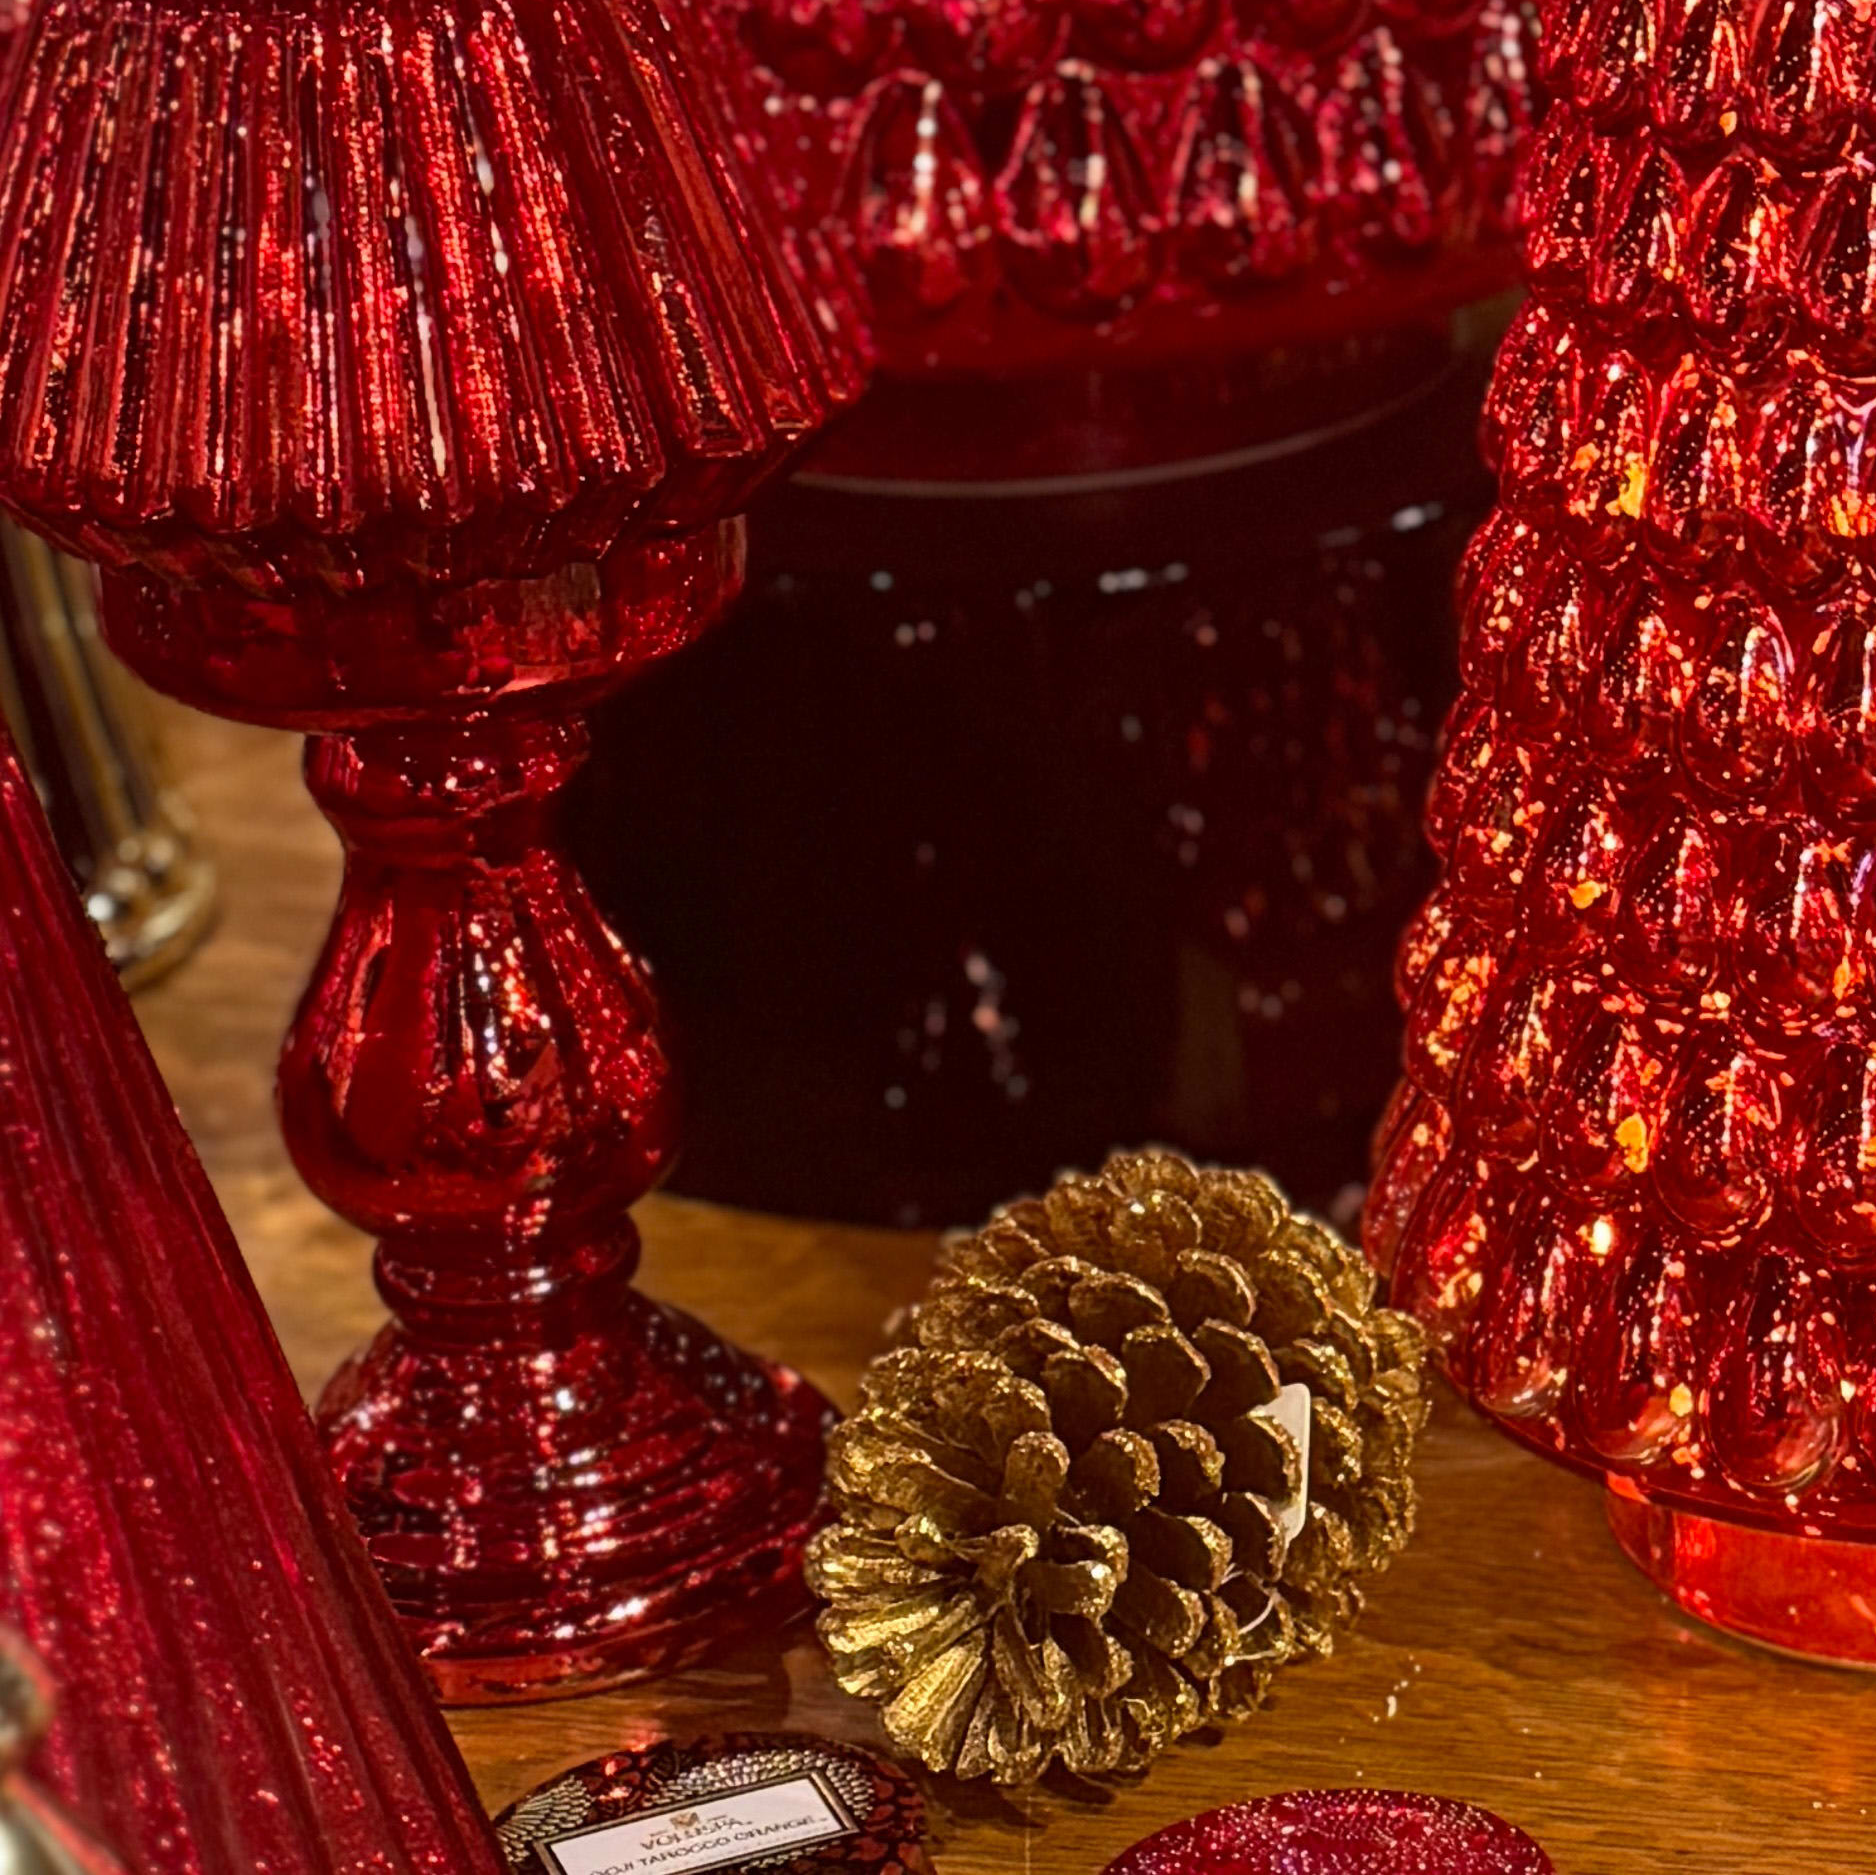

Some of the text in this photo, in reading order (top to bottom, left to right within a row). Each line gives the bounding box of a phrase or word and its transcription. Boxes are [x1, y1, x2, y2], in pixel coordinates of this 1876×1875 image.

[639, 1817, 743, 1851] VOLUSPA
[640, 1837, 730, 1867] TAROCCO
[734, 1815, 813, 1843] ORANGE
